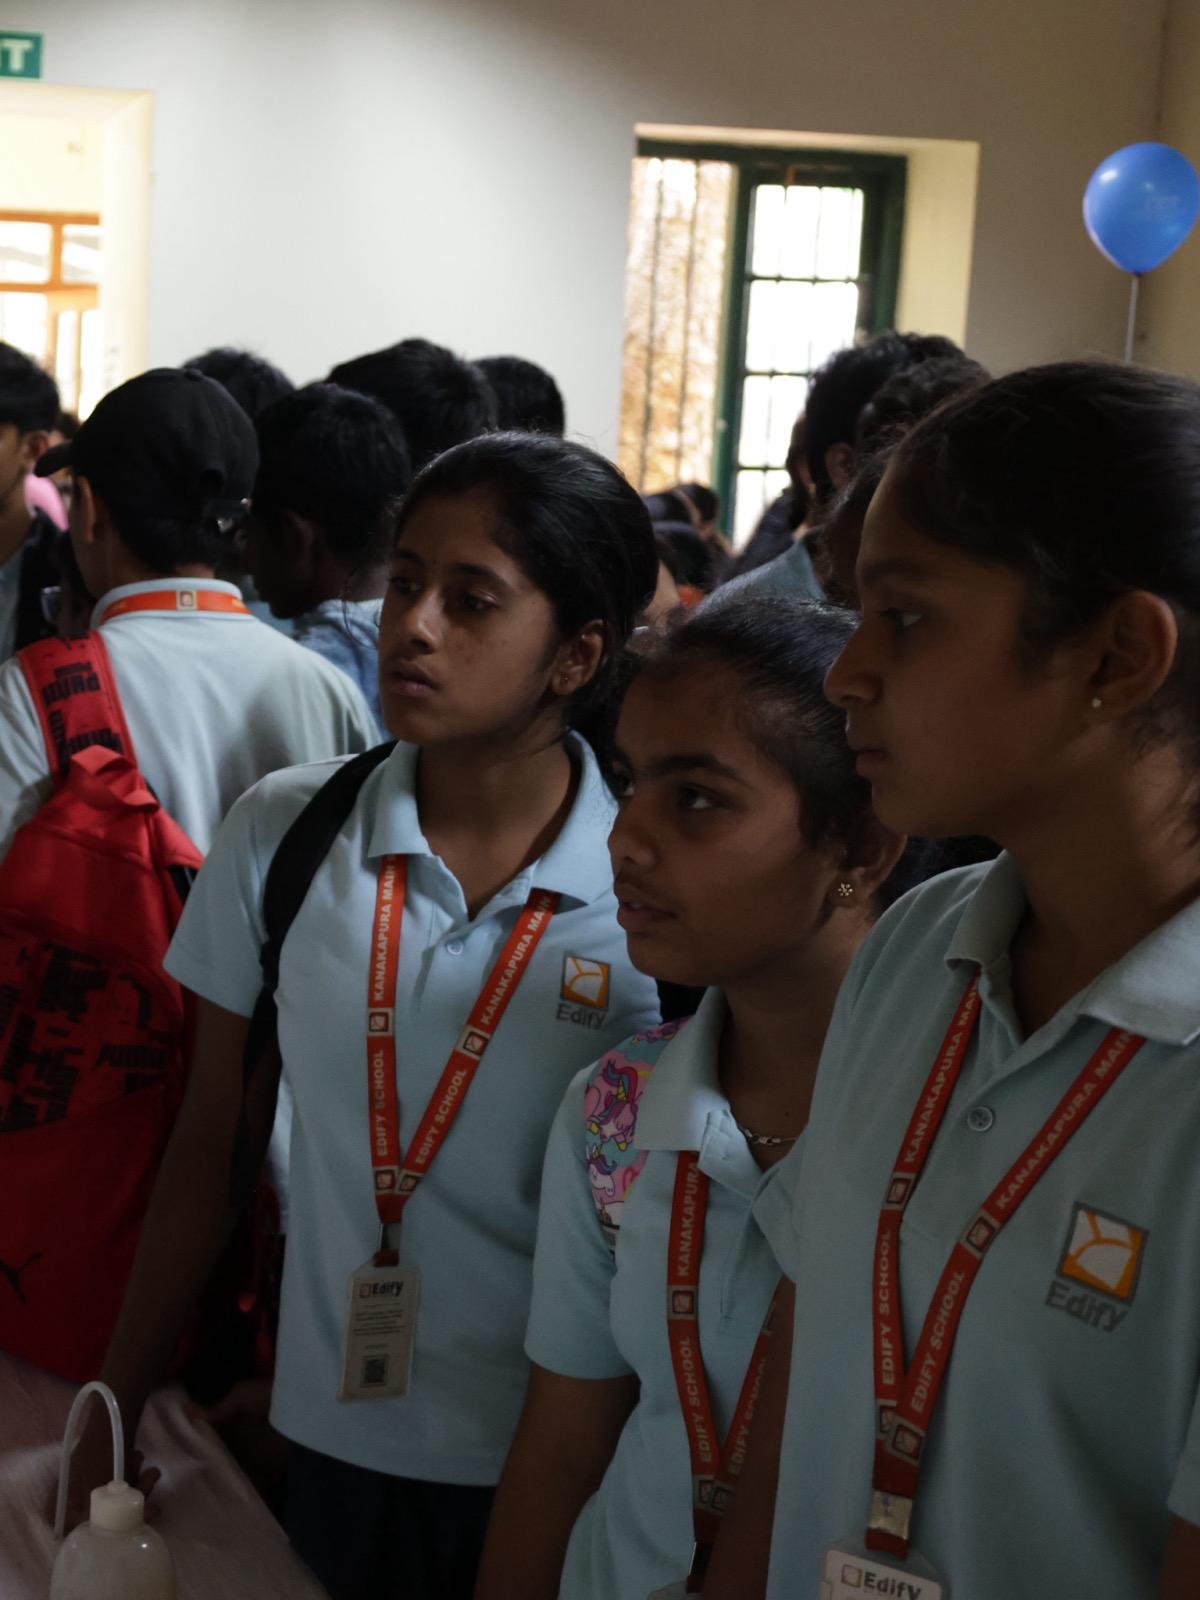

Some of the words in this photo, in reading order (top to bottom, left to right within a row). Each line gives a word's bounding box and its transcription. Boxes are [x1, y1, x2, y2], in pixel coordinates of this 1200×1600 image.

[374, 904, 393, 1001] KANAKAPURA
[481, 933, 533, 1026] KANAKAPURA
[531, 896, 551, 934] MAIN
[556, 1003, 608, 1030] Edify
[374, 1048, 385, 1110] SCHOOL
[905, 1032, 963, 1163] KANAKAPURA
[375, 1115, 388, 1157] EDIFY
[415, 1120, 438, 1164] EDIFY
[434, 1068, 467, 1123] SCHOOL
[995, 1081, 1097, 1209] KANAKAPURA
[677, 1163, 700, 1277] KANAKAPURA
[373, 1281, 404, 1297] Edify
[878, 1229, 891, 1315] SCHOOL
[1046, 1280, 1128, 1332] Edify
[680, 1336, 702, 1407] SCHOOL
[880, 1324, 893, 1386] EDIFY
[911, 1352, 939, 1414] EDIFY
[930, 1271, 965, 1350] SCHOOL
[693, 1413, 712, 1464] EDIFY
[728, 1424, 752, 1475] EDIFY
[863, 1571, 921, 1600] Edify
